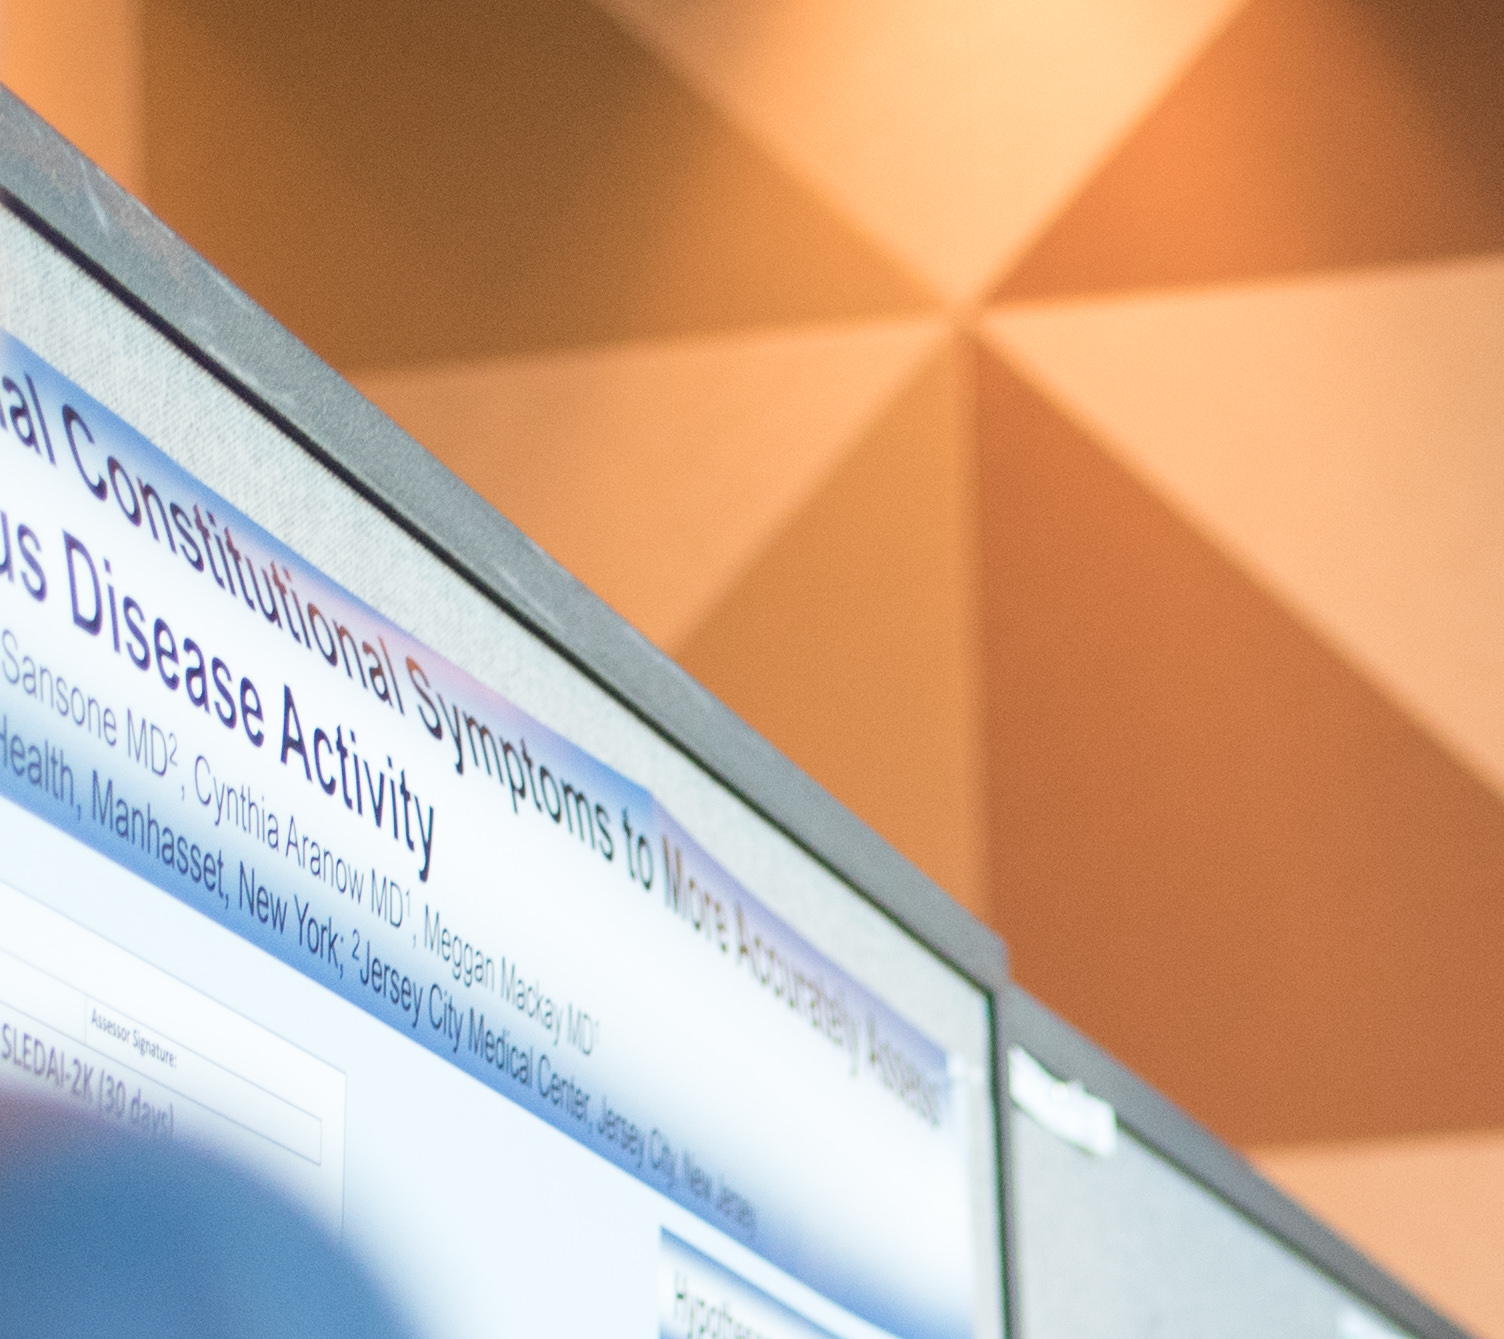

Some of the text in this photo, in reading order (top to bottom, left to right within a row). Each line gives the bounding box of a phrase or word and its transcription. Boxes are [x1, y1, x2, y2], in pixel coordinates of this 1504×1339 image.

[1, 628, 117, 747] Sansone
[194, 755, 279, 852] Cynthia
[285, 815, 364, 905] Aranow
[424, 903, 495, 988] Meggan
[501, 956, 563, 1047] Mackay
[61, 403, 405, 717] Constitutional
[405, 655, 615, 863] Symptoms
[622, 805, 654, 892] to
[662, 834, 728, 954] More
[62, 528, 265, 748] Disease
[280, 684, 435, 883] Activity
[1, 1022, 94, 1102] SLEDAI-2K
[91, 1007, 177, 1067] Assessor Signature:
[92, 769, 230, 910] Manhasset,
[238, 860, 288, 936] New
[428, 983, 464, 1054] City
[468, 1006, 533, 1089] Medical
